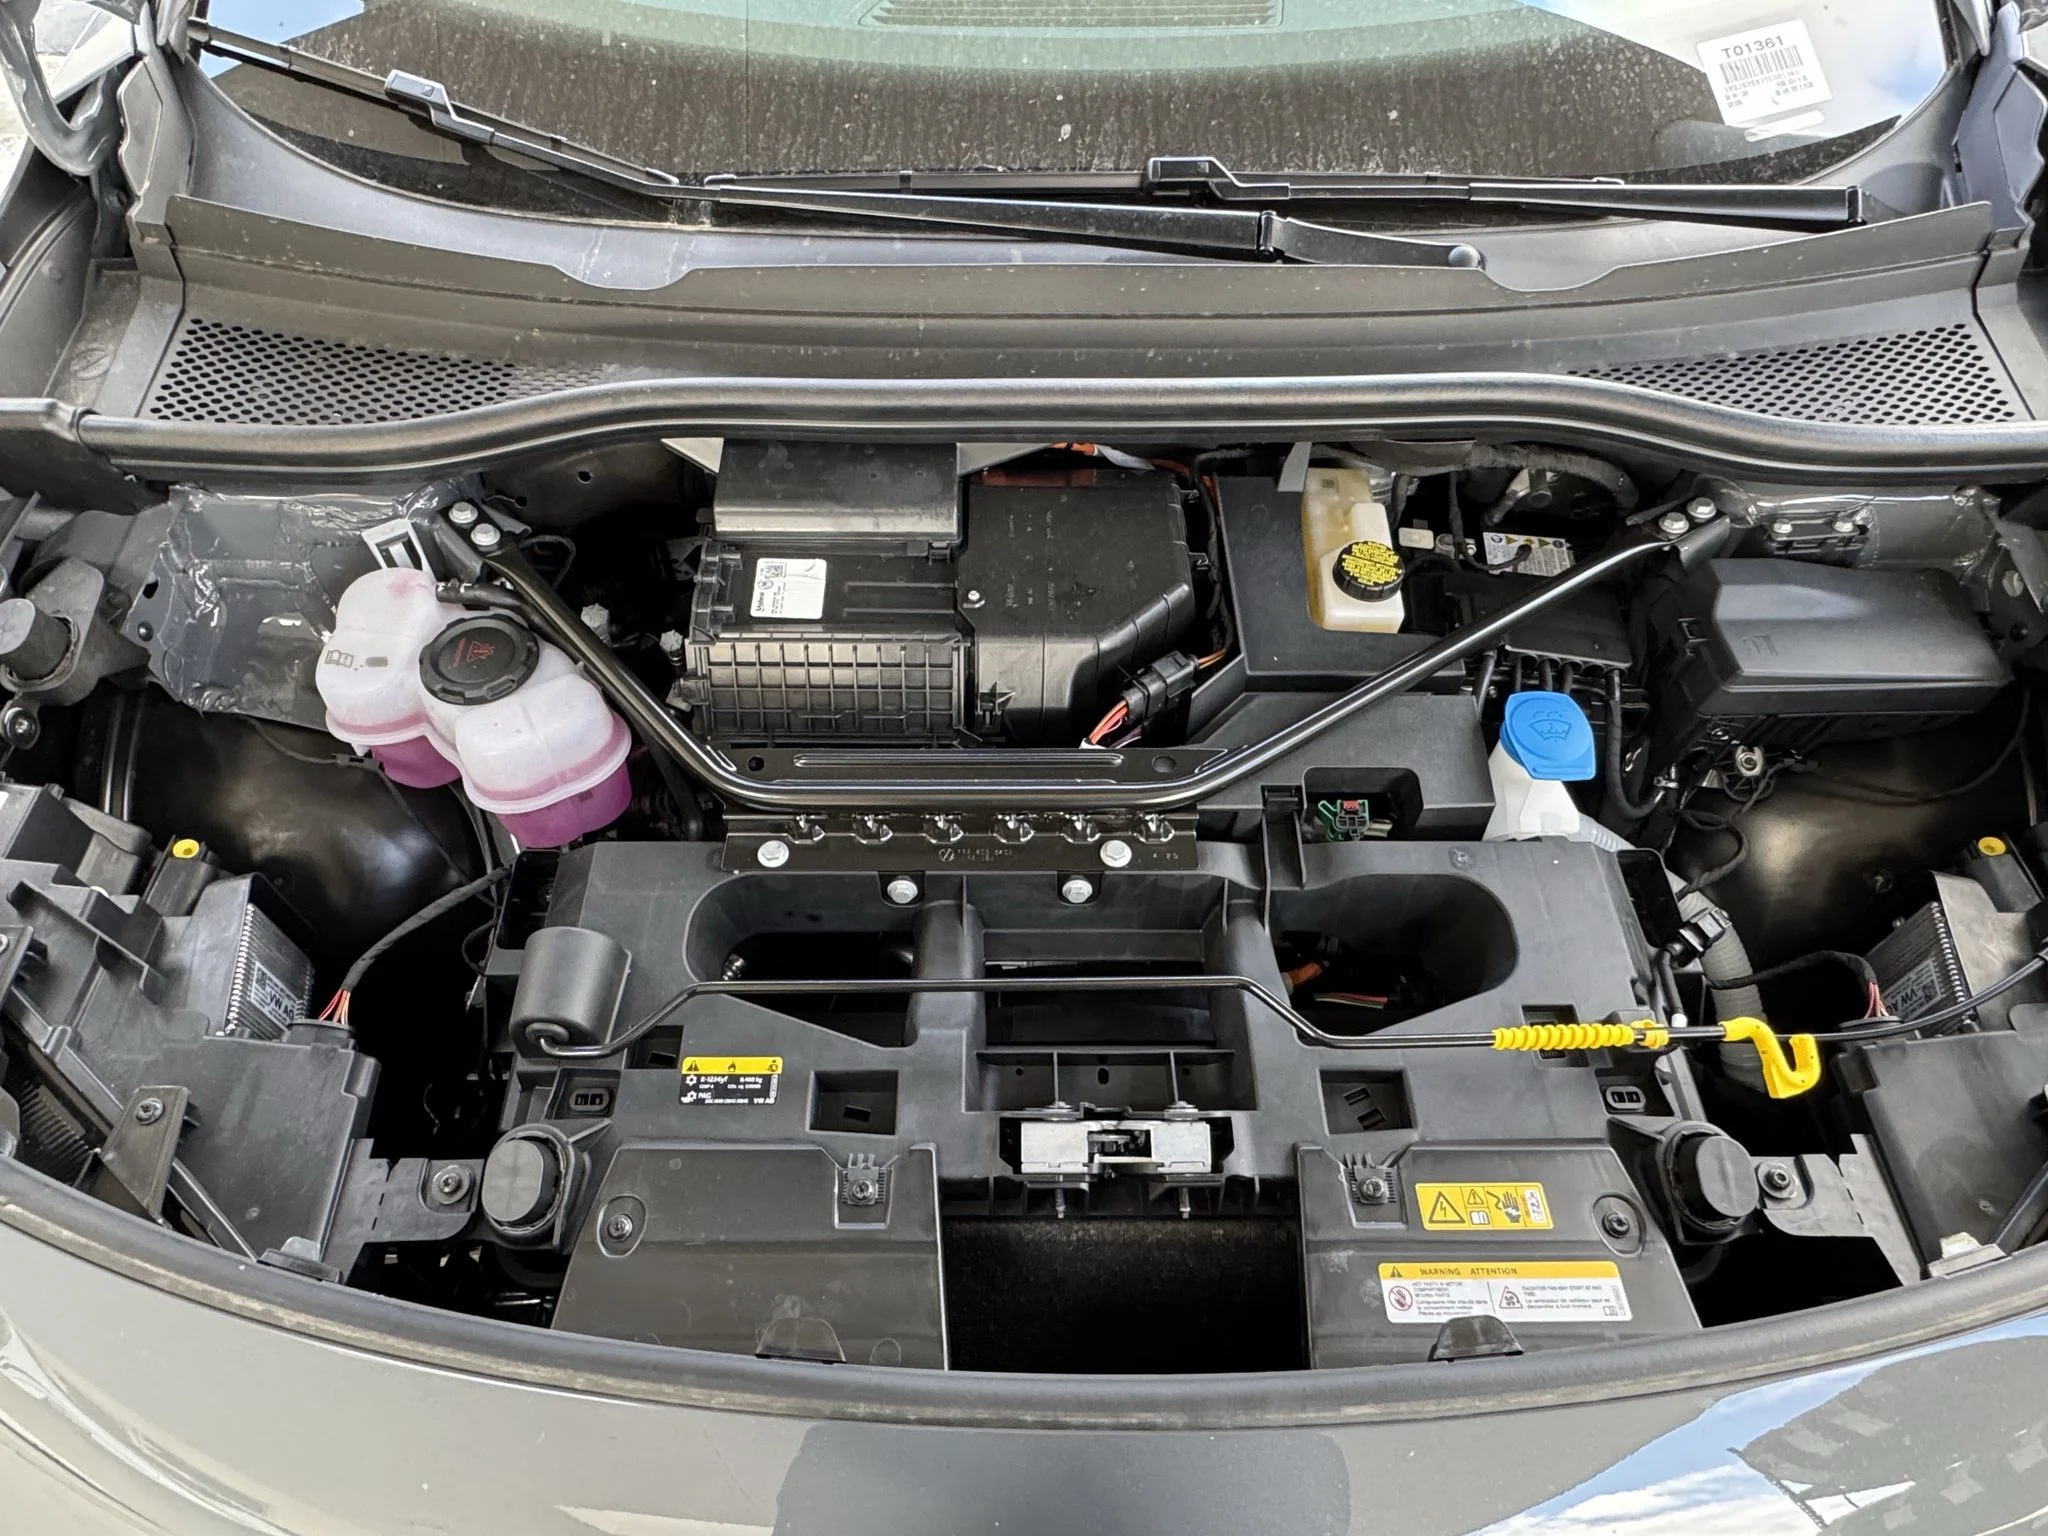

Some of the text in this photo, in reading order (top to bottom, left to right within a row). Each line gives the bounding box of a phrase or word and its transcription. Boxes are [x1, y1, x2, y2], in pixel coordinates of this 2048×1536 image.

[1721, 35, 1784, 59] T01361
[1420, 1267, 1518, 1276] WARNING ATTENTION
